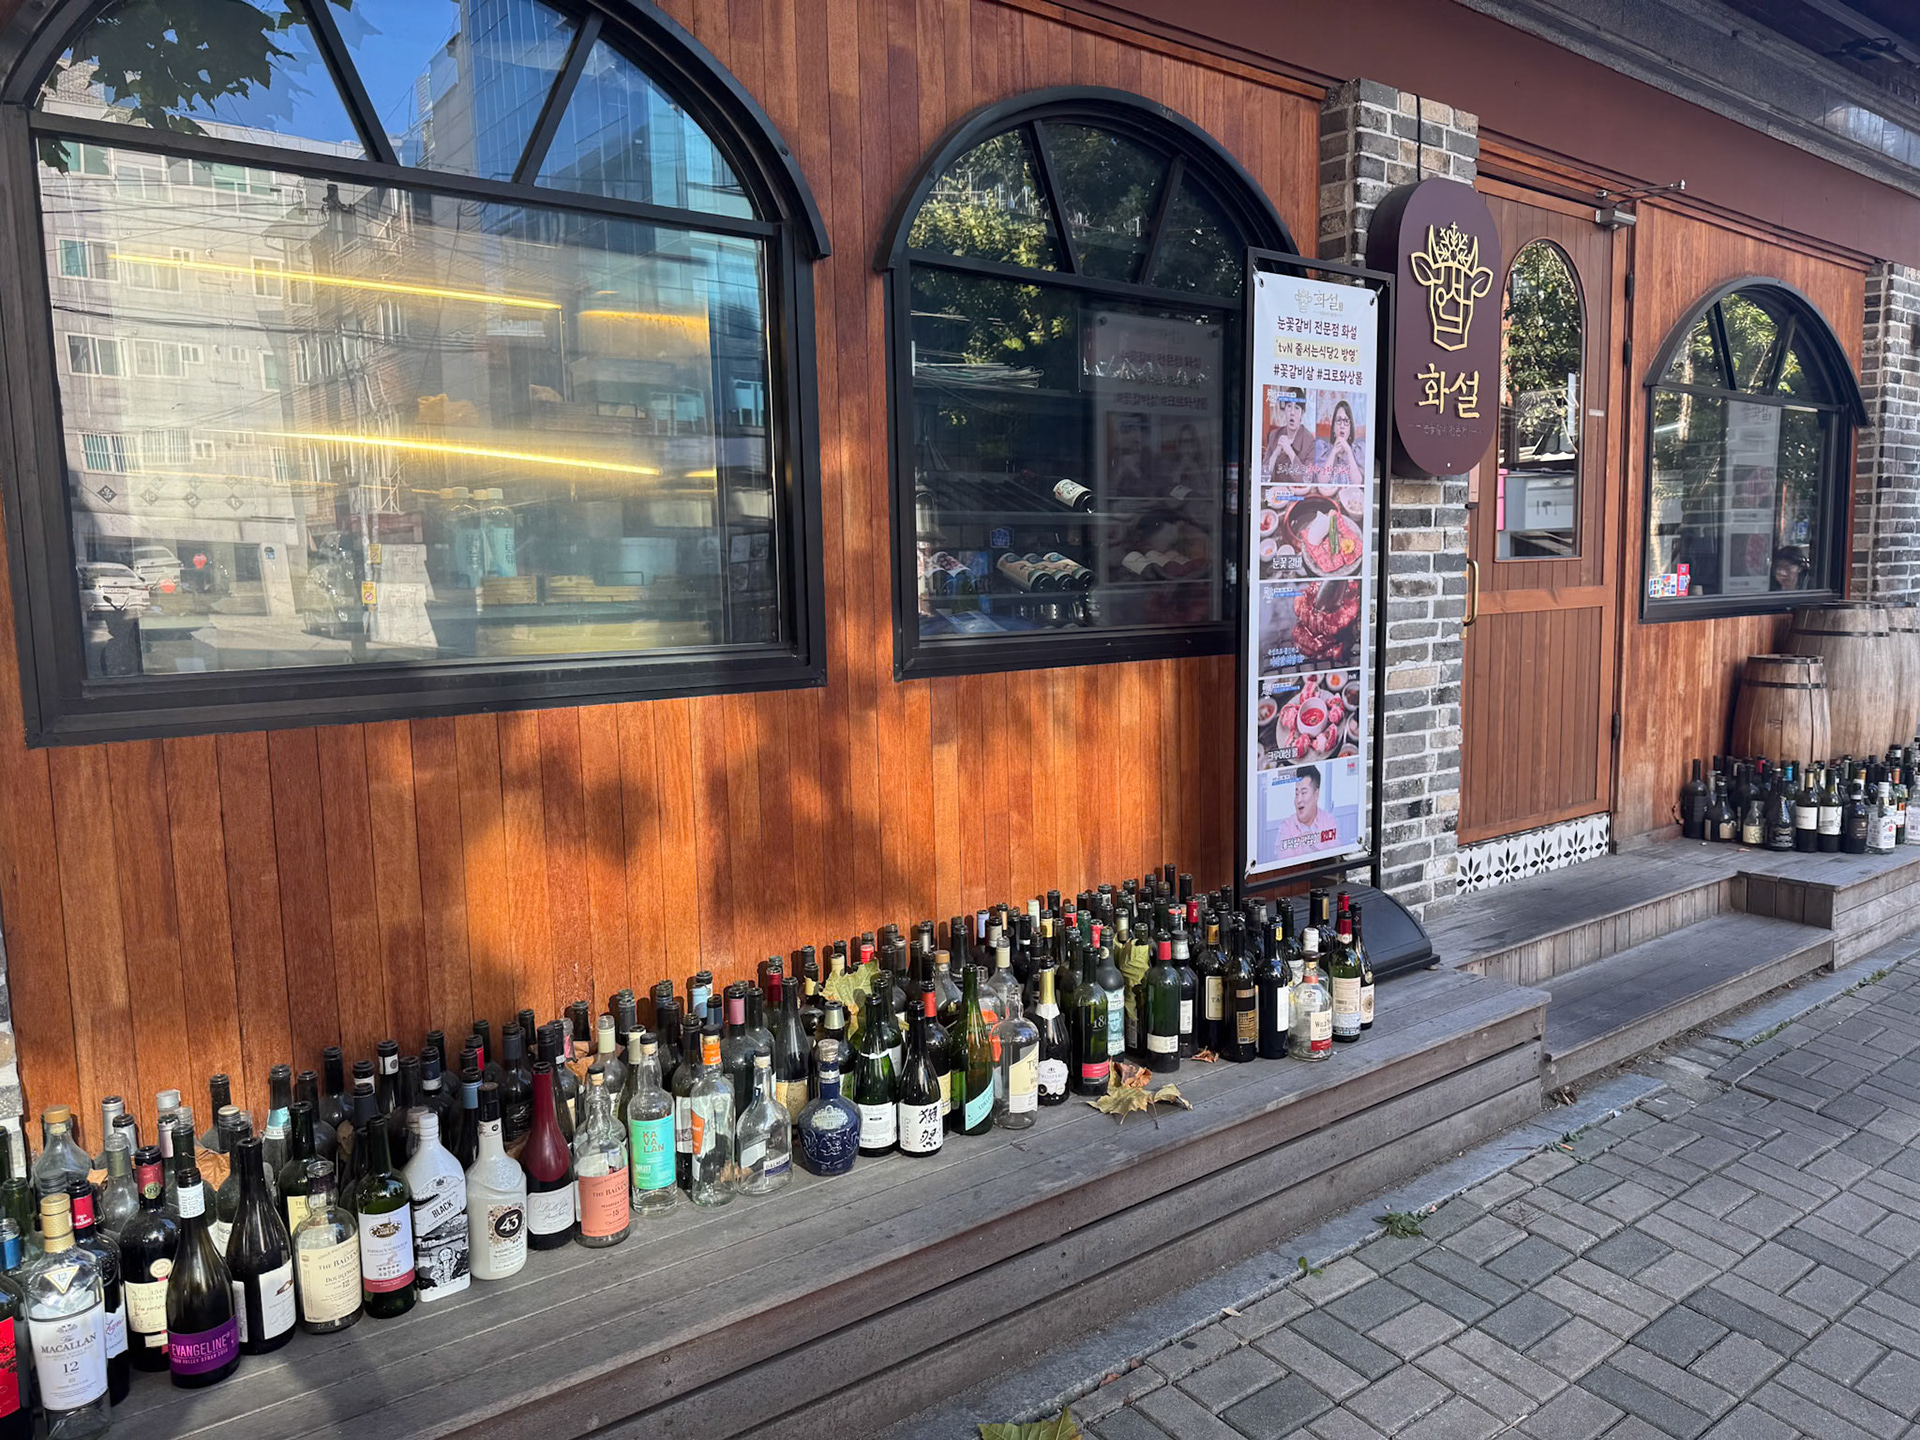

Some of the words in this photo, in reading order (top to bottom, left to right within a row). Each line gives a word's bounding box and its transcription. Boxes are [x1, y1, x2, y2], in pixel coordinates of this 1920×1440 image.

[1277, 316, 1312, 334] 눈꽃갈비
[1314, 322, 1340, 338] 전문점
[1341, 324, 1358, 340] 화설
[1295, 344, 1339, 360] 줄서는식당2
[1273, 364, 1315, 380] #꽃갈비살
[1316, 368, 1364, 386] #크로와상롤
[1417, 362, 1480, 418] 화설
[431, 1200, 454, 1218] BLACK
[500, 1214, 519, 1232] 43
[56, 1273, 68, 1281] 12
[342, 1280, 351, 1288] 12
[40, 1331, 98, 1354] MACALLAN
[171, 1334, 228, 1357] EVANGELINE
[63, 1361, 80, 1374] 12
